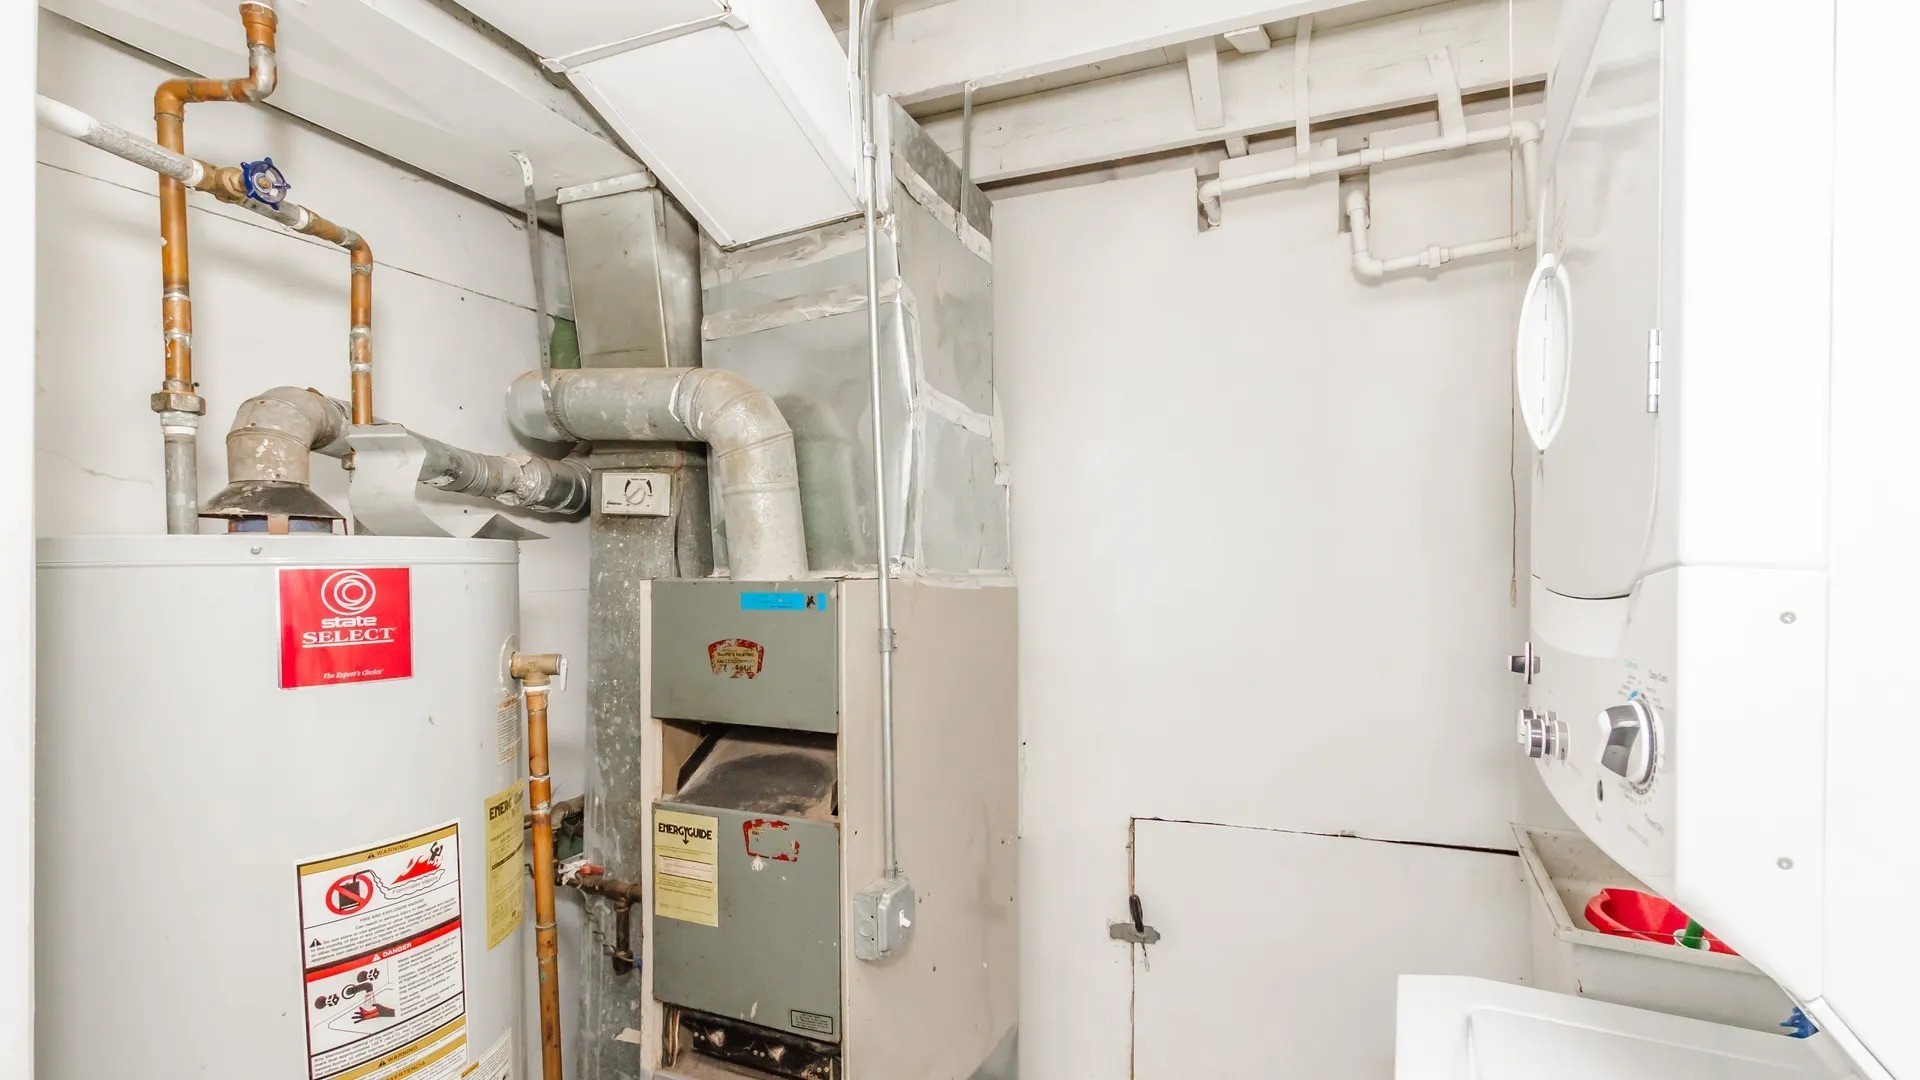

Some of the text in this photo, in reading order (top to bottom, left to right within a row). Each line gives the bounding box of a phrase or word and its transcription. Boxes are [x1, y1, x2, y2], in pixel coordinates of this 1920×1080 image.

[321, 616, 377, 629] state
[302, 627, 395, 645] SELECT
[336, 670, 361, 679] Expert's
[377, 843, 410, 856] WARNING
[382, 943, 412, 958] DANGER
[388, 1045, 418, 1062] WARNING
[386, 1061, 426, 1080] VERTENCIA
